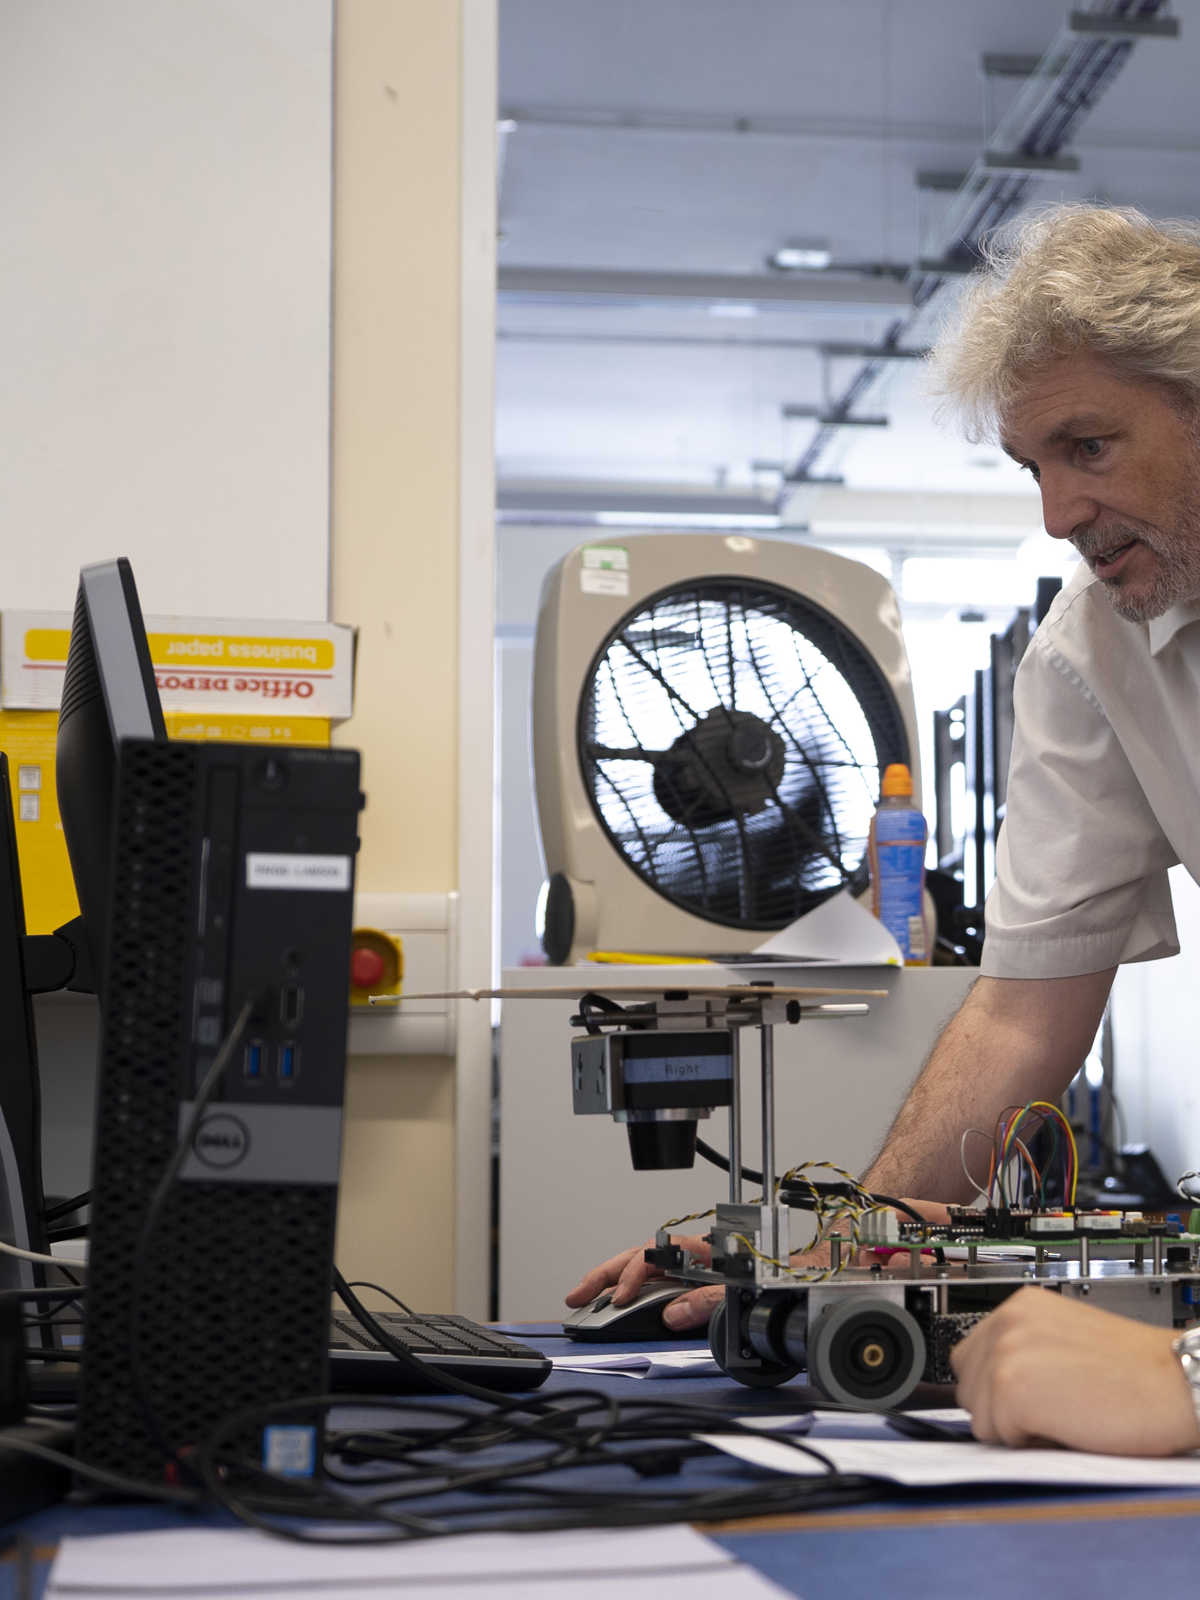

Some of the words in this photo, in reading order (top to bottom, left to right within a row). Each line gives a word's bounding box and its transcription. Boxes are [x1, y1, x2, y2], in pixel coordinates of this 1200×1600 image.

[166, 638, 224, 657] paper
[228, 640, 317, 664] business
[234, 677, 315, 699] Office
